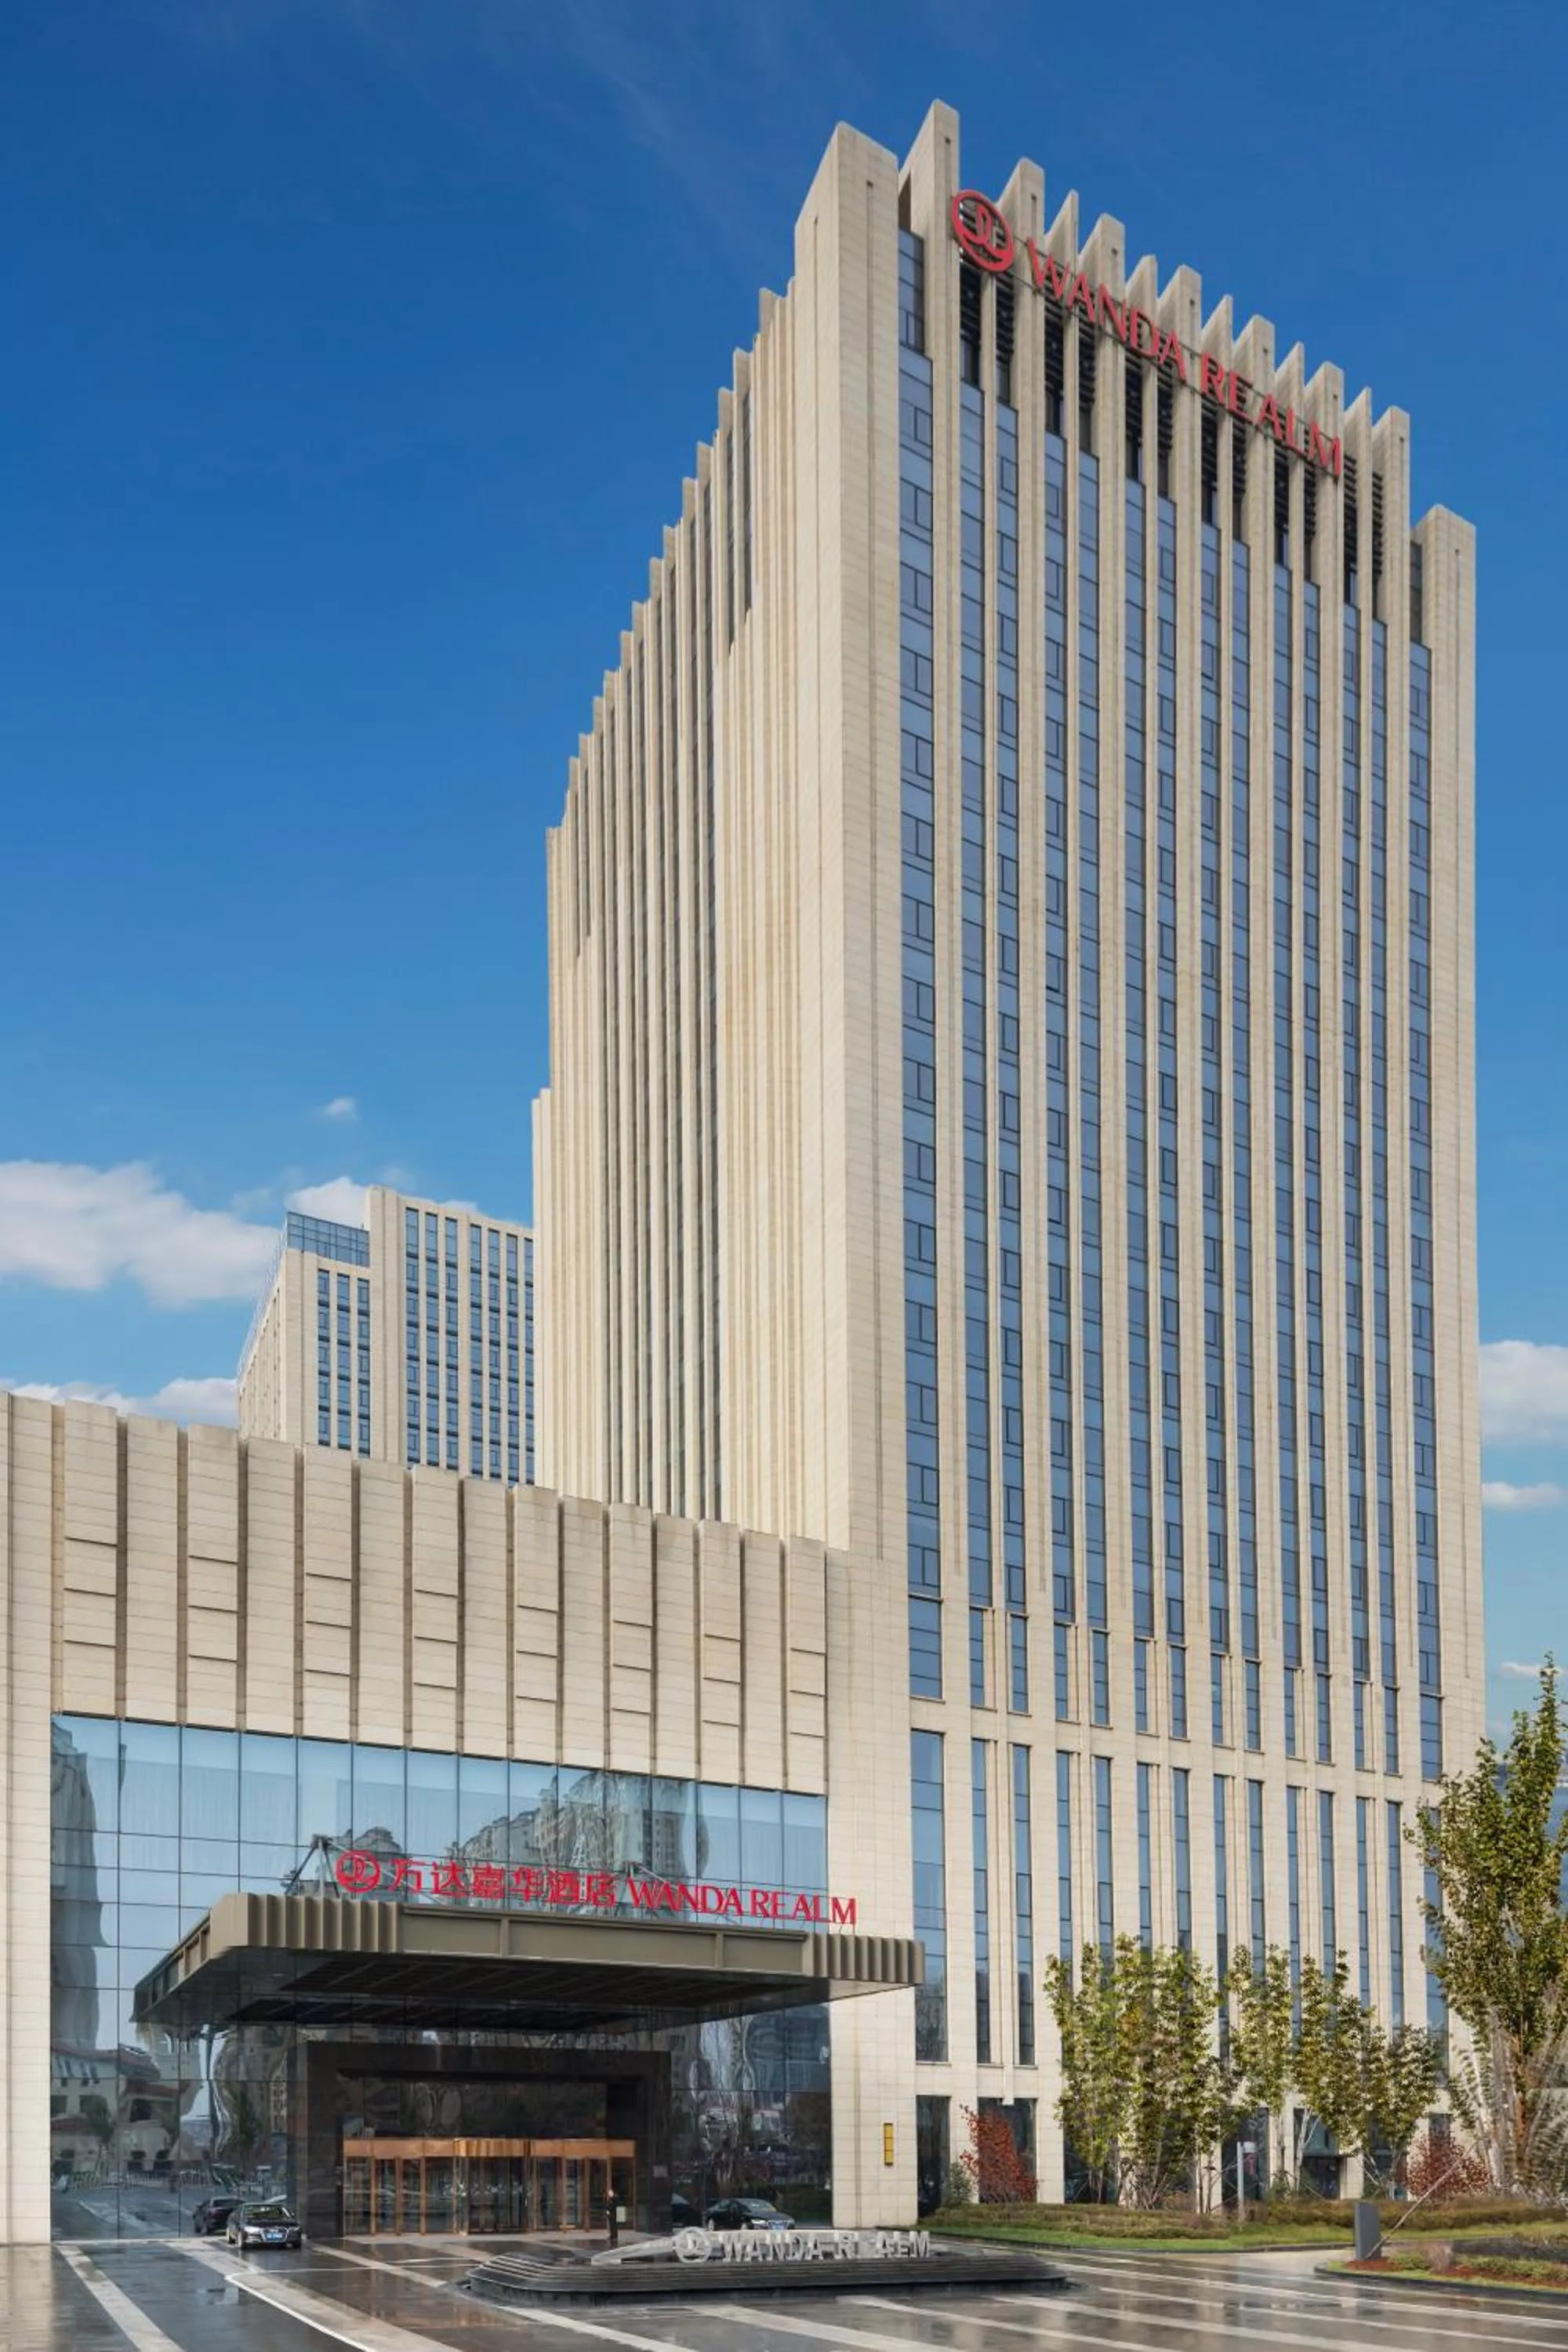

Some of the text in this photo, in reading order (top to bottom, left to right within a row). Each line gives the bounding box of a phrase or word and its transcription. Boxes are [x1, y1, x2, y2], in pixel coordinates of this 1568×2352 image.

[1026, 238, 1342, 478] WANDA REALM
[388, 1857, 856, 1925] 万达嘉华酒店 WANDA REALM
[718, 2231, 824, 2262] WANDA
